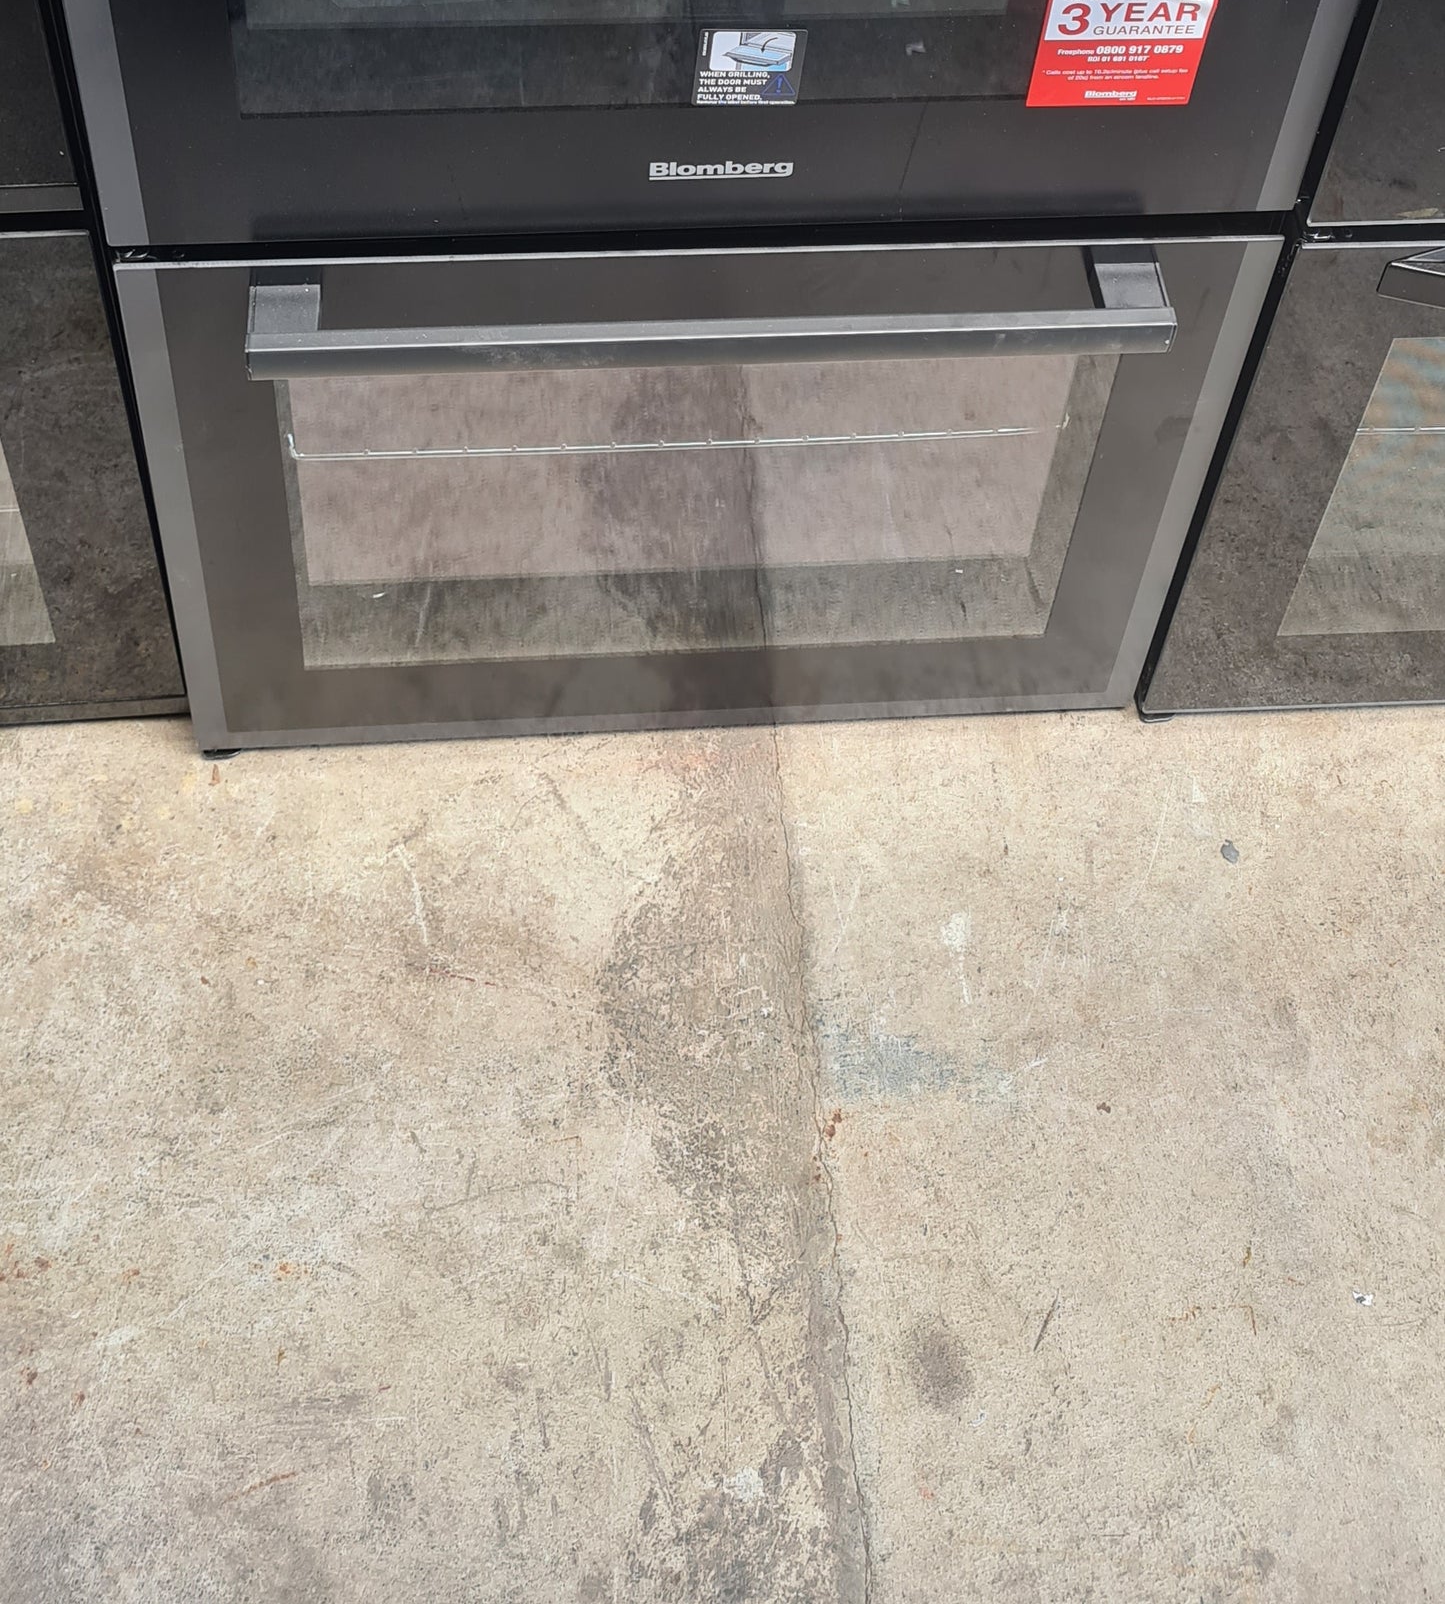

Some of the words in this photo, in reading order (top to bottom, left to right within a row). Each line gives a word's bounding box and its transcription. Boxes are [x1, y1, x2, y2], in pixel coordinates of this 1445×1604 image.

[1057, 3, 1092, 36] 3
[1100, 2, 1202, 23] YEAR
[1093, 25, 1196, 36] GUARANTEE
[1096, 46, 1125, 55] 0800
[1129, 45, 1152, 55] 917
[1154, 45, 1184, 54] 0879
[728, 71, 770, 79] GRILLING,
[1084, 90, 1137, 99] Blomberg
[649, 160, 794, 180] Blomberg
